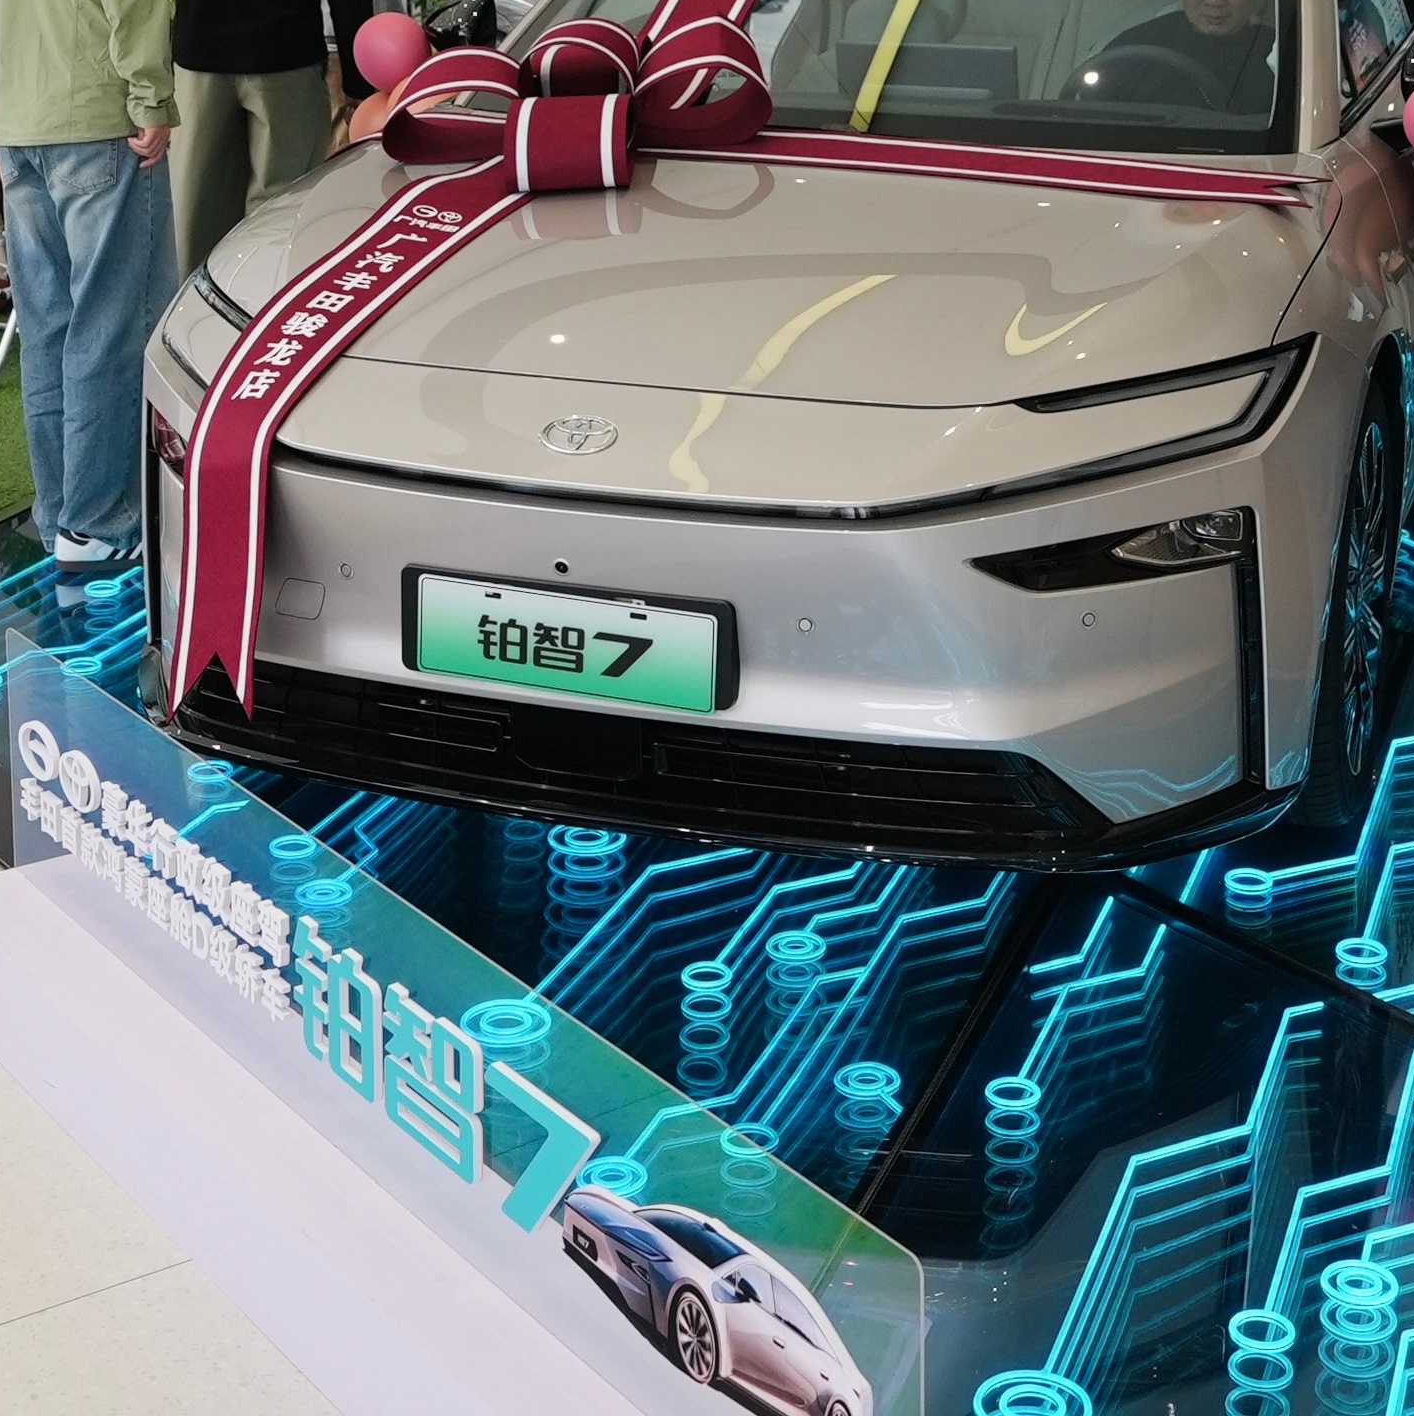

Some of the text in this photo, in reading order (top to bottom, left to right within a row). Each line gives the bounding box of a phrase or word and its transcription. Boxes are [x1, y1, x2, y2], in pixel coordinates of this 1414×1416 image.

[232, 232, 428, 400] 广汽丰田骏龙店
[476, 614, 655, 677] 铂智7
[20, 777, 293, 1022] 丰田首款鸿蒙座舱D级轿车
[101, 780, 290, 968] 豪华行政级座驾
[292, 914, 602, 1234] 铂智7
